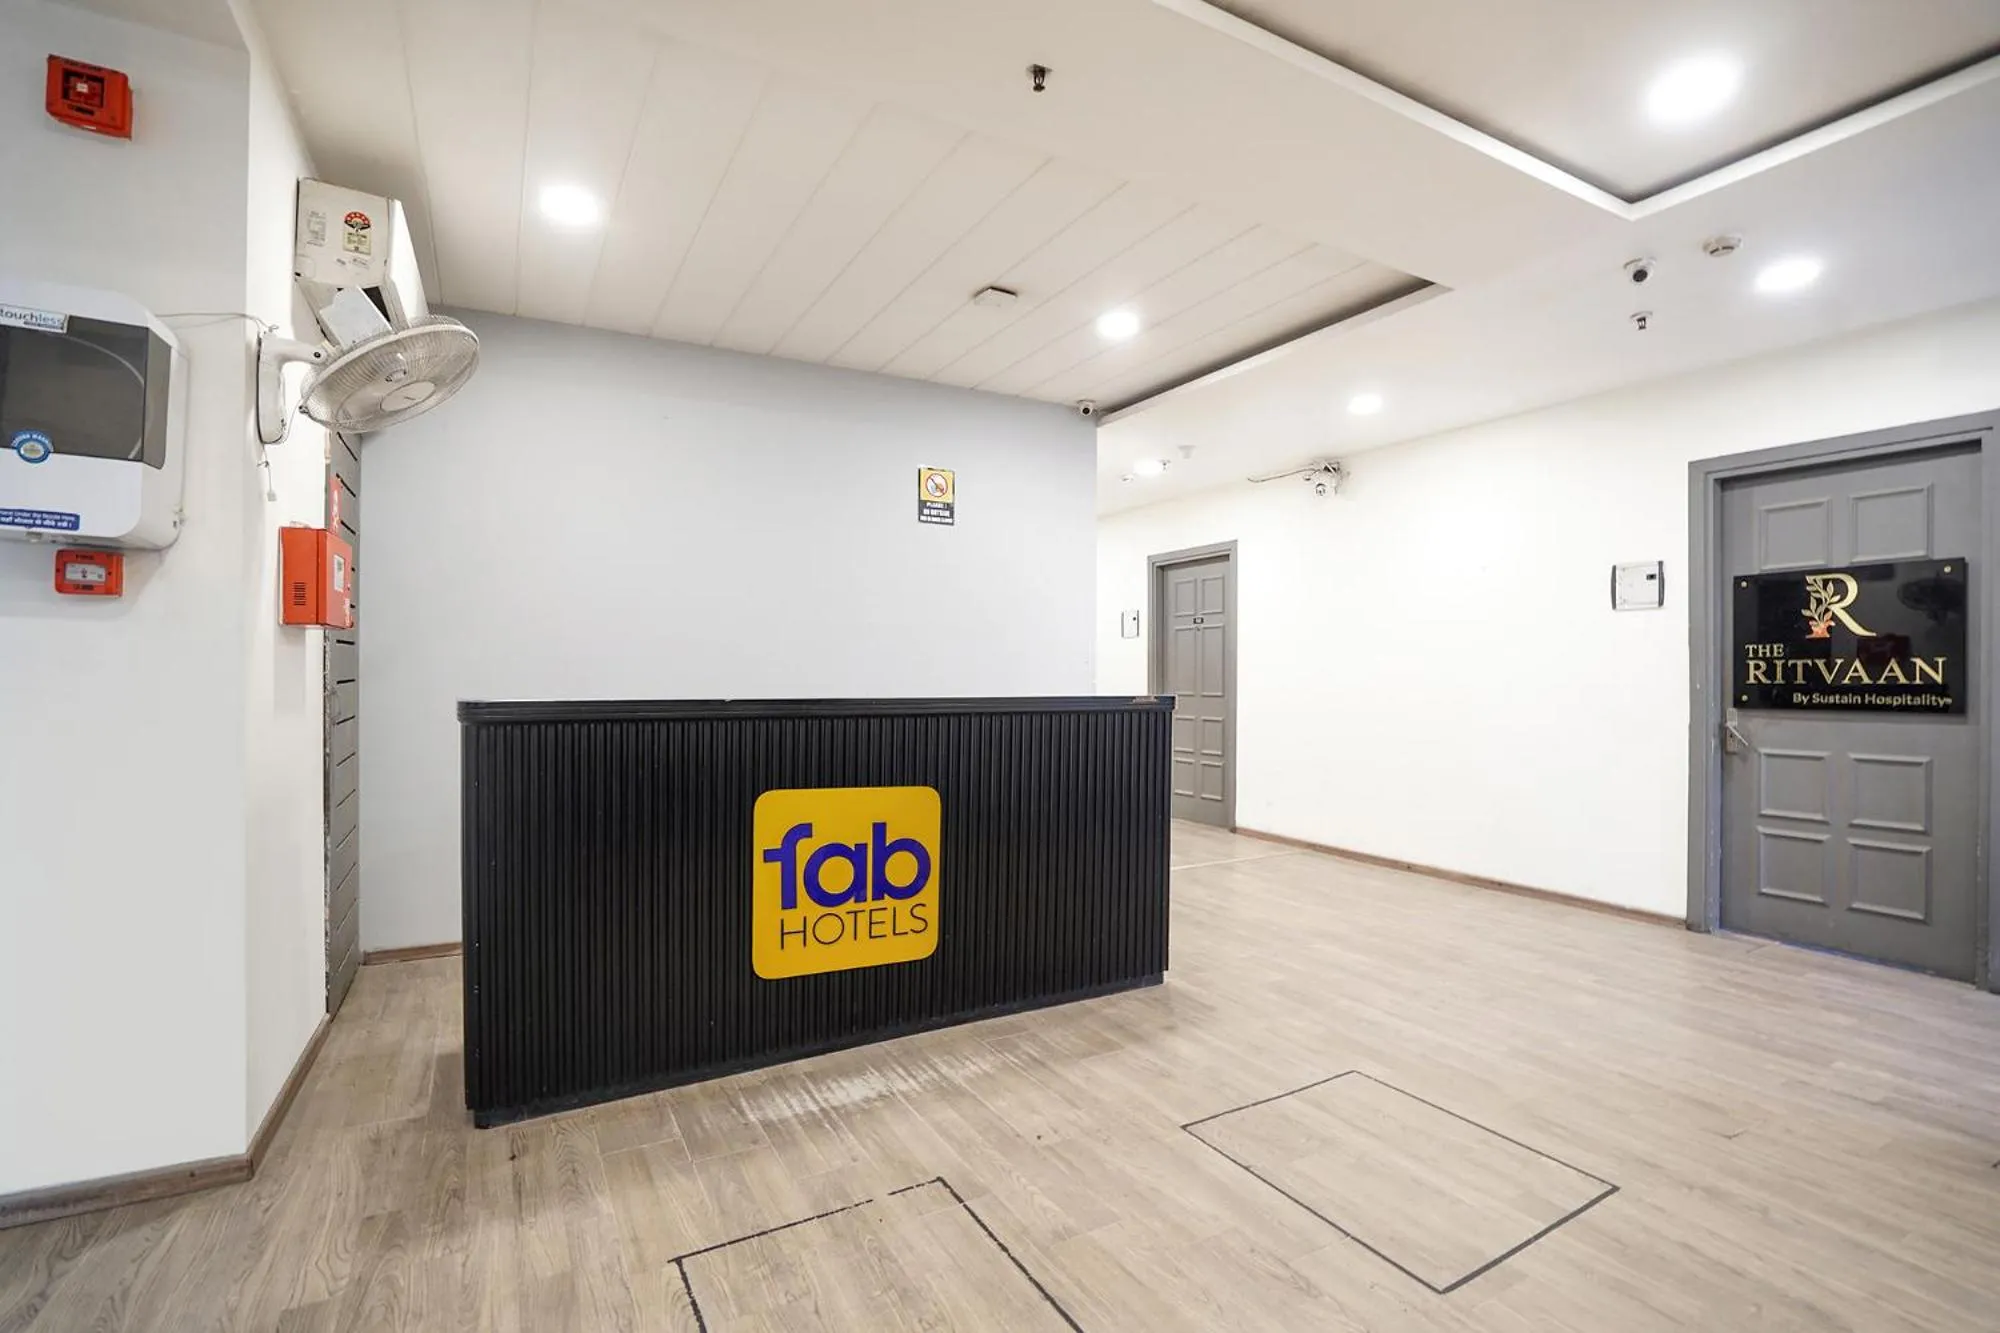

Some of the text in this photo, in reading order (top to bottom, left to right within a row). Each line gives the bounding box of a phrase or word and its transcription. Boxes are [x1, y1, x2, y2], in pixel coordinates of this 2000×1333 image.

[1745, 643, 1784, 658] THE
[1745, 657, 1947, 685] RITVAAN
[1793, 692, 1945, 708] By Sustain Hospitality
[763, 821, 932, 910] fab
[780, 903, 929, 950] HOTELS
